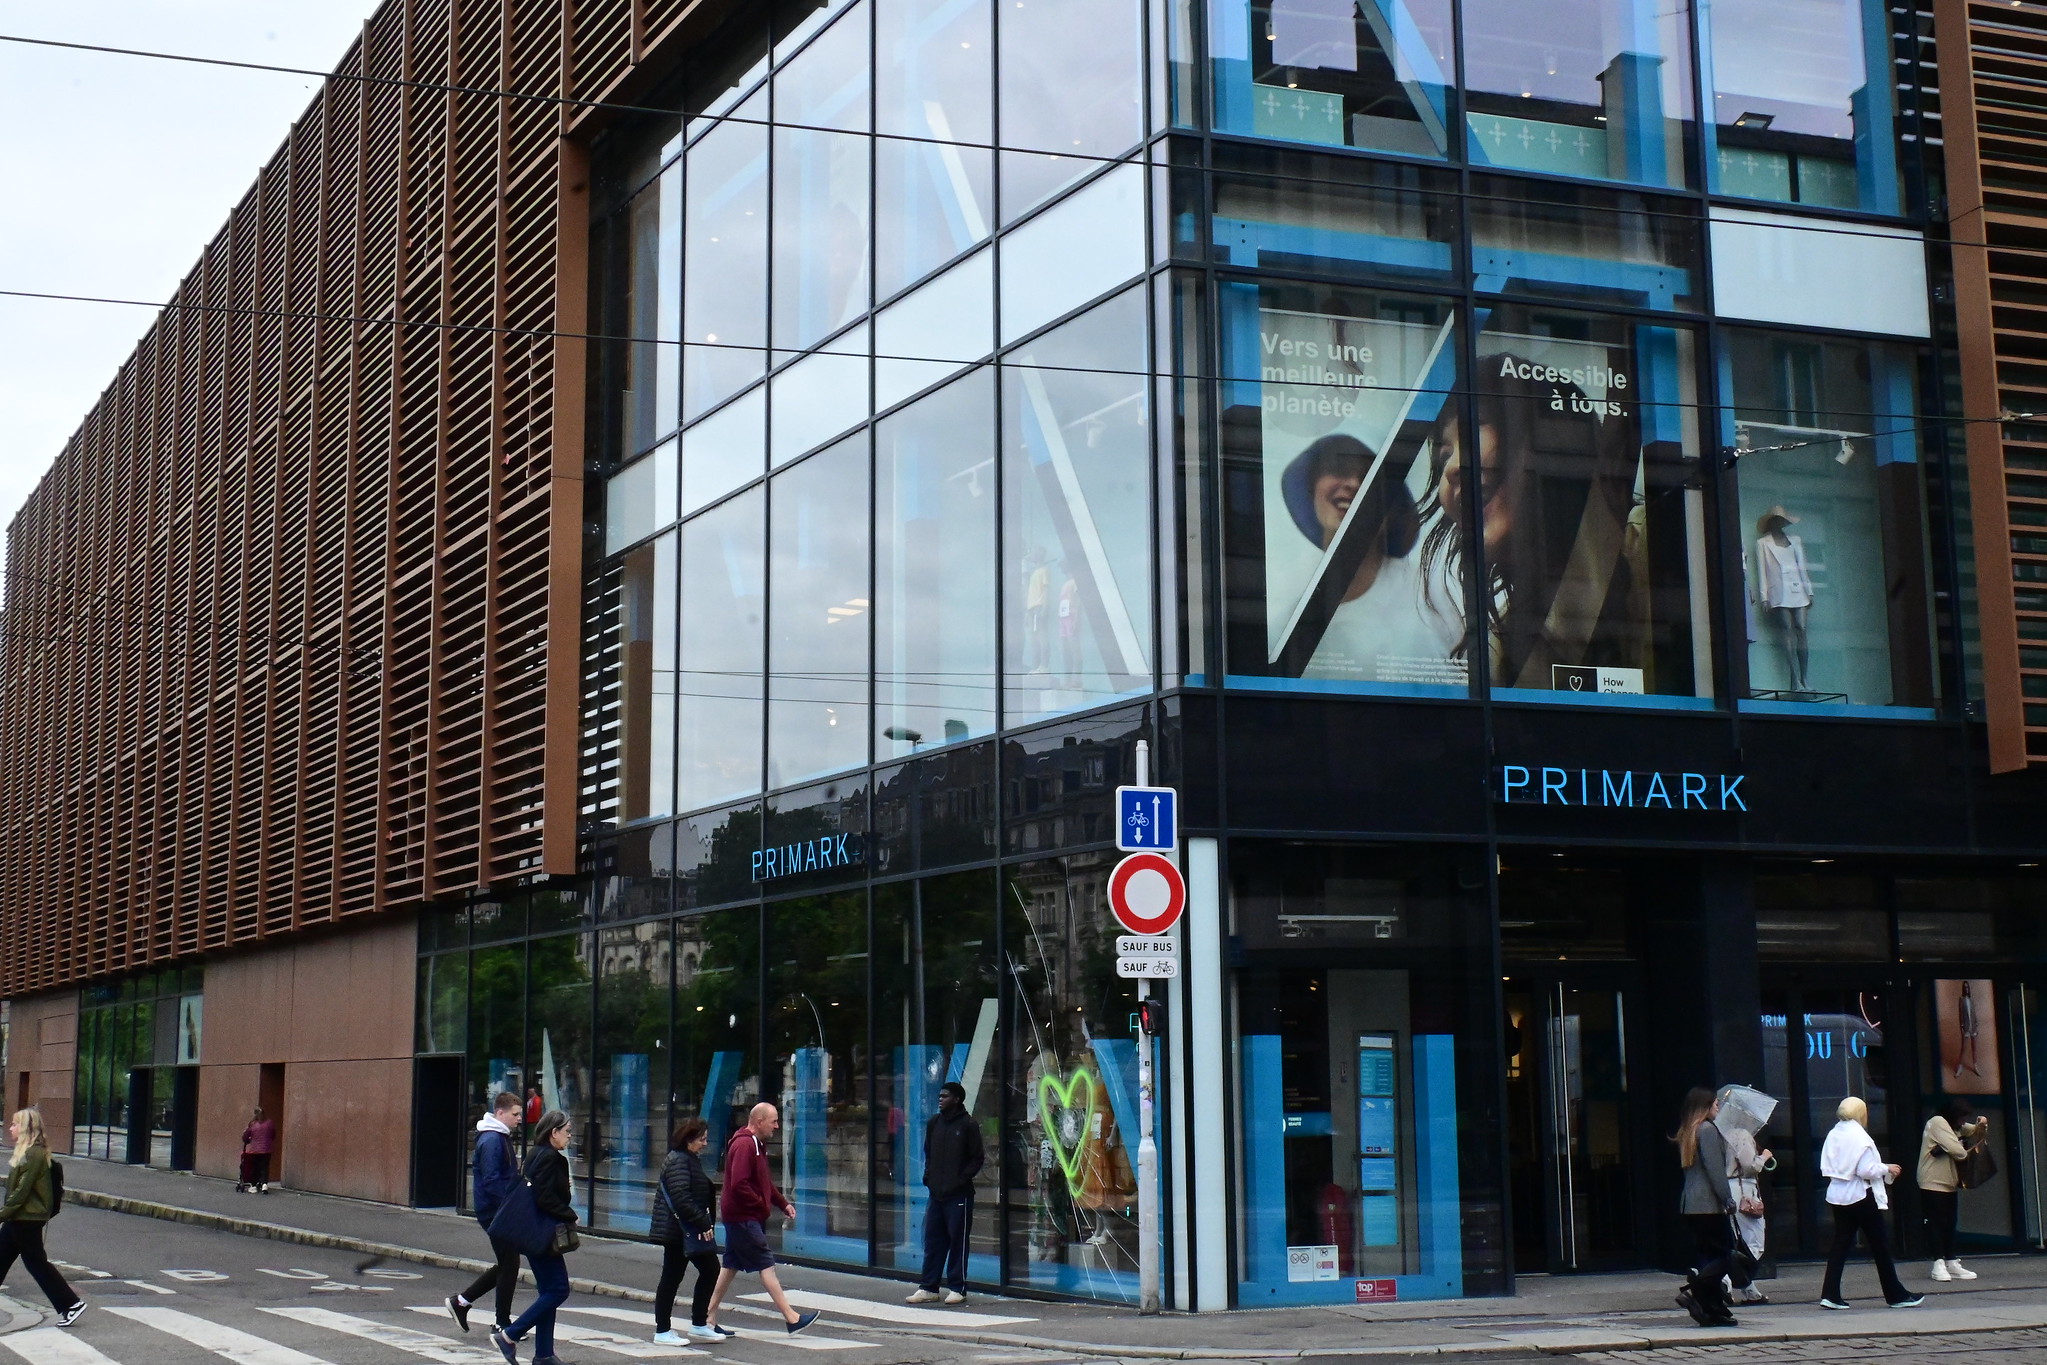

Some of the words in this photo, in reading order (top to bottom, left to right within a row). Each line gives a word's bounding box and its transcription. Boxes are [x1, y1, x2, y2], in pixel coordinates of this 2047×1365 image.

[1261, 332, 1319, 358] Vers
[1327, 343, 1373, 363] une
[1262, 364, 1379, 391] meilleure
[1500, 356, 1628, 390] Accessible
[1262, 391, 1362, 420] planète.
[1550, 388, 1564, 411] à
[1570, 392, 1628, 417] tous.
[1603, 677, 1624, 687] How
[1503, 765, 1748, 811] PRIMARK
[752, 832, 849, 881] PRIMARK
[1122, 942, 1149, 952] SAUF
[1153, 942, 1173, 952] BUS
[1123, 962, 1148, 972] SAUF
[1357, 1282, 1374, 1293] top
